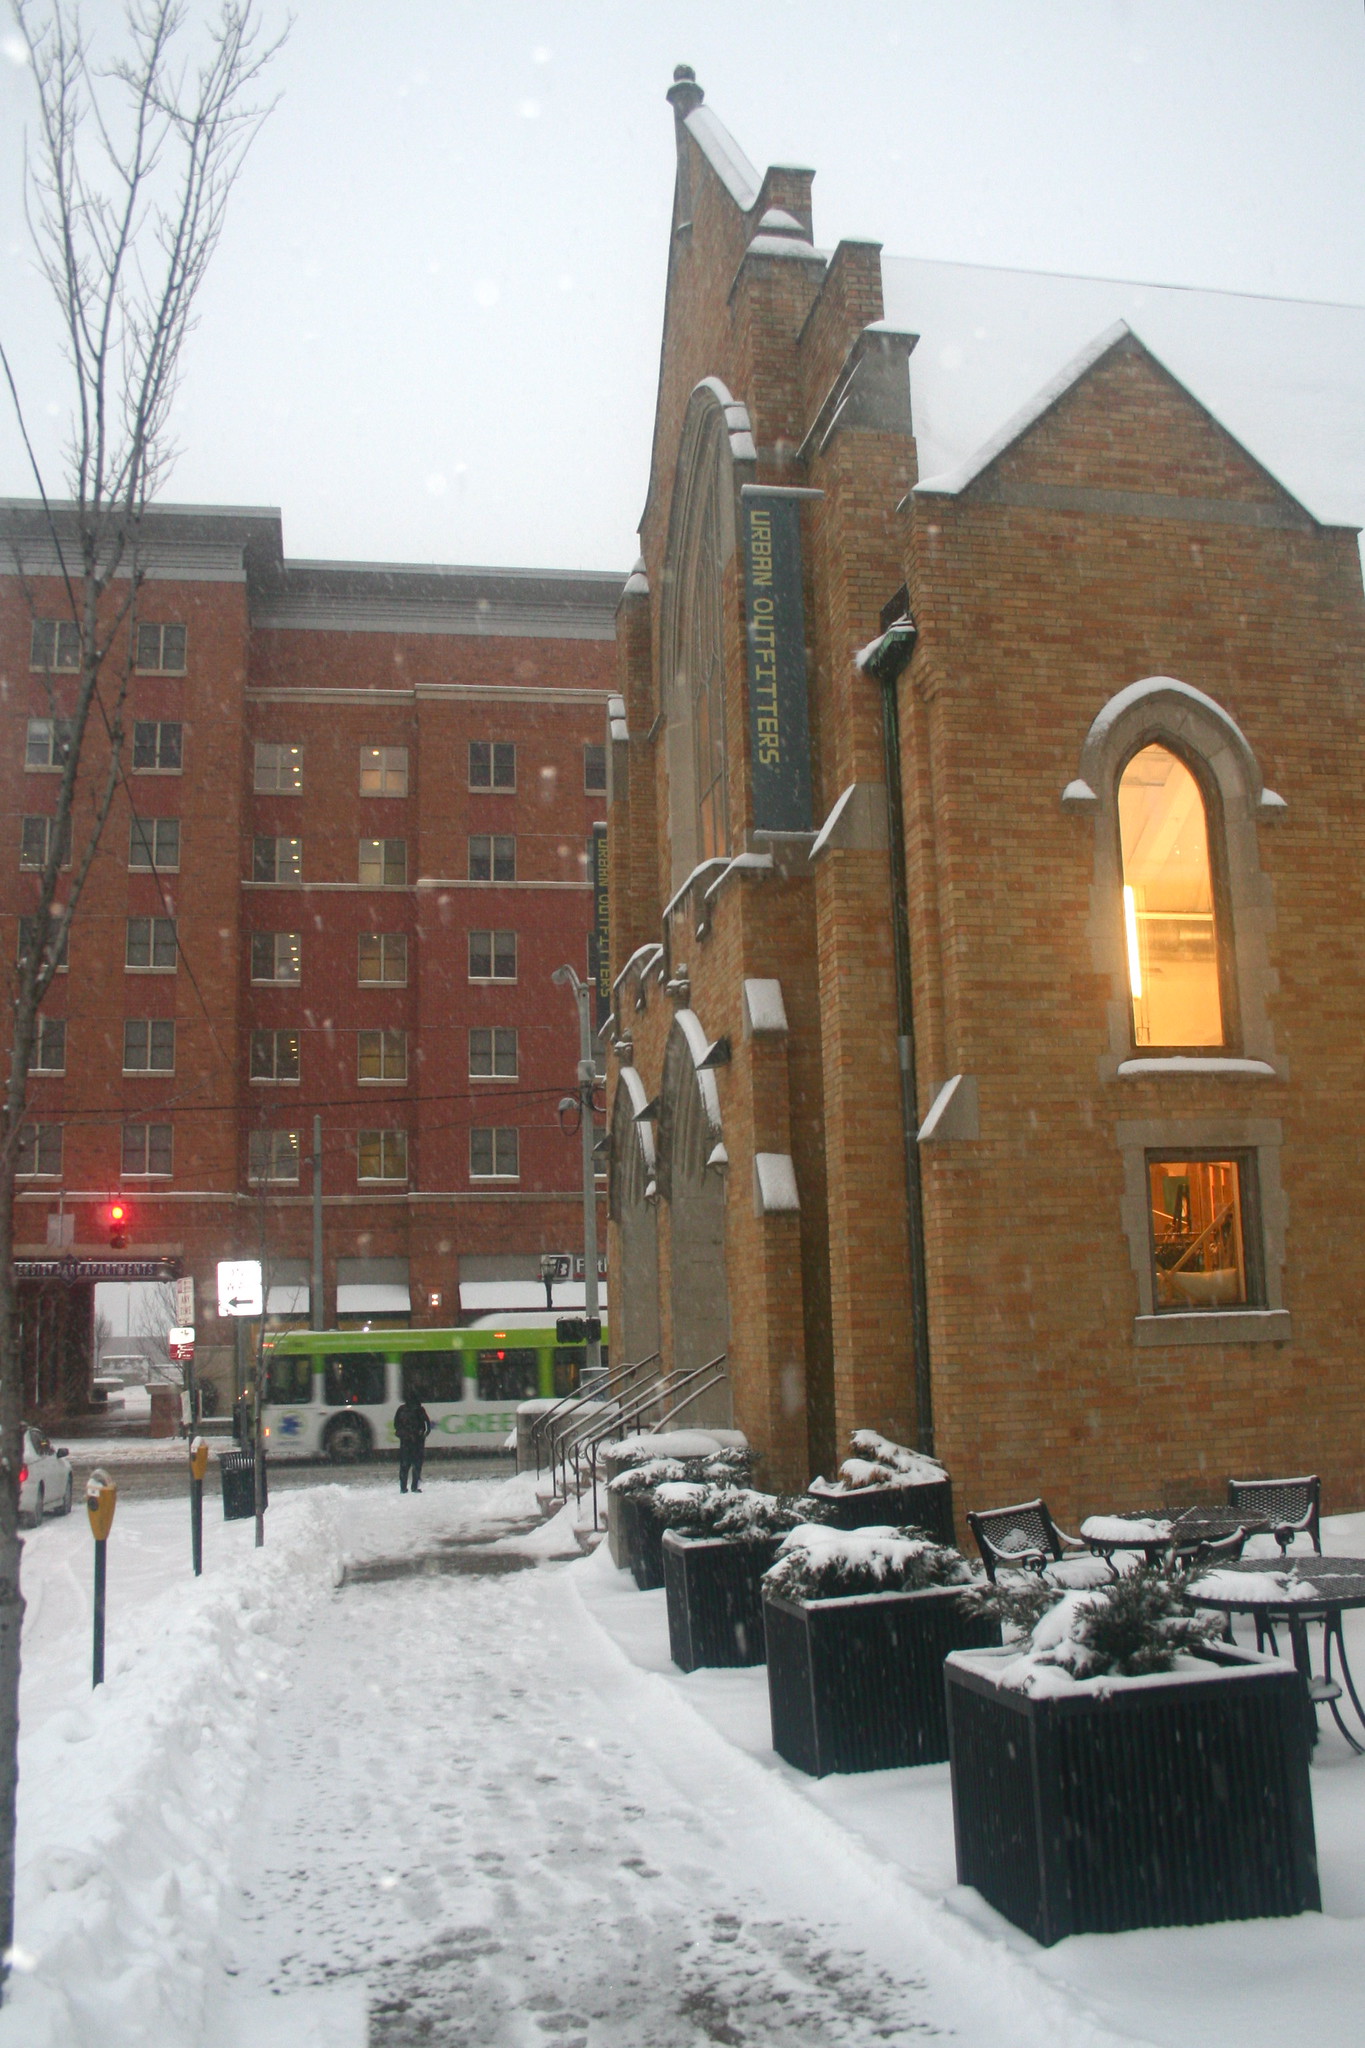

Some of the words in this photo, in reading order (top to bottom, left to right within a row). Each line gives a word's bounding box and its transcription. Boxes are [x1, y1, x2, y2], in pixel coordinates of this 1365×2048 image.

[750, 510, 773, 586] URBAN
[752, 598, 779, 764] OUTFITTERS
[84, 1264, 154, 1276] APARTMENTS
